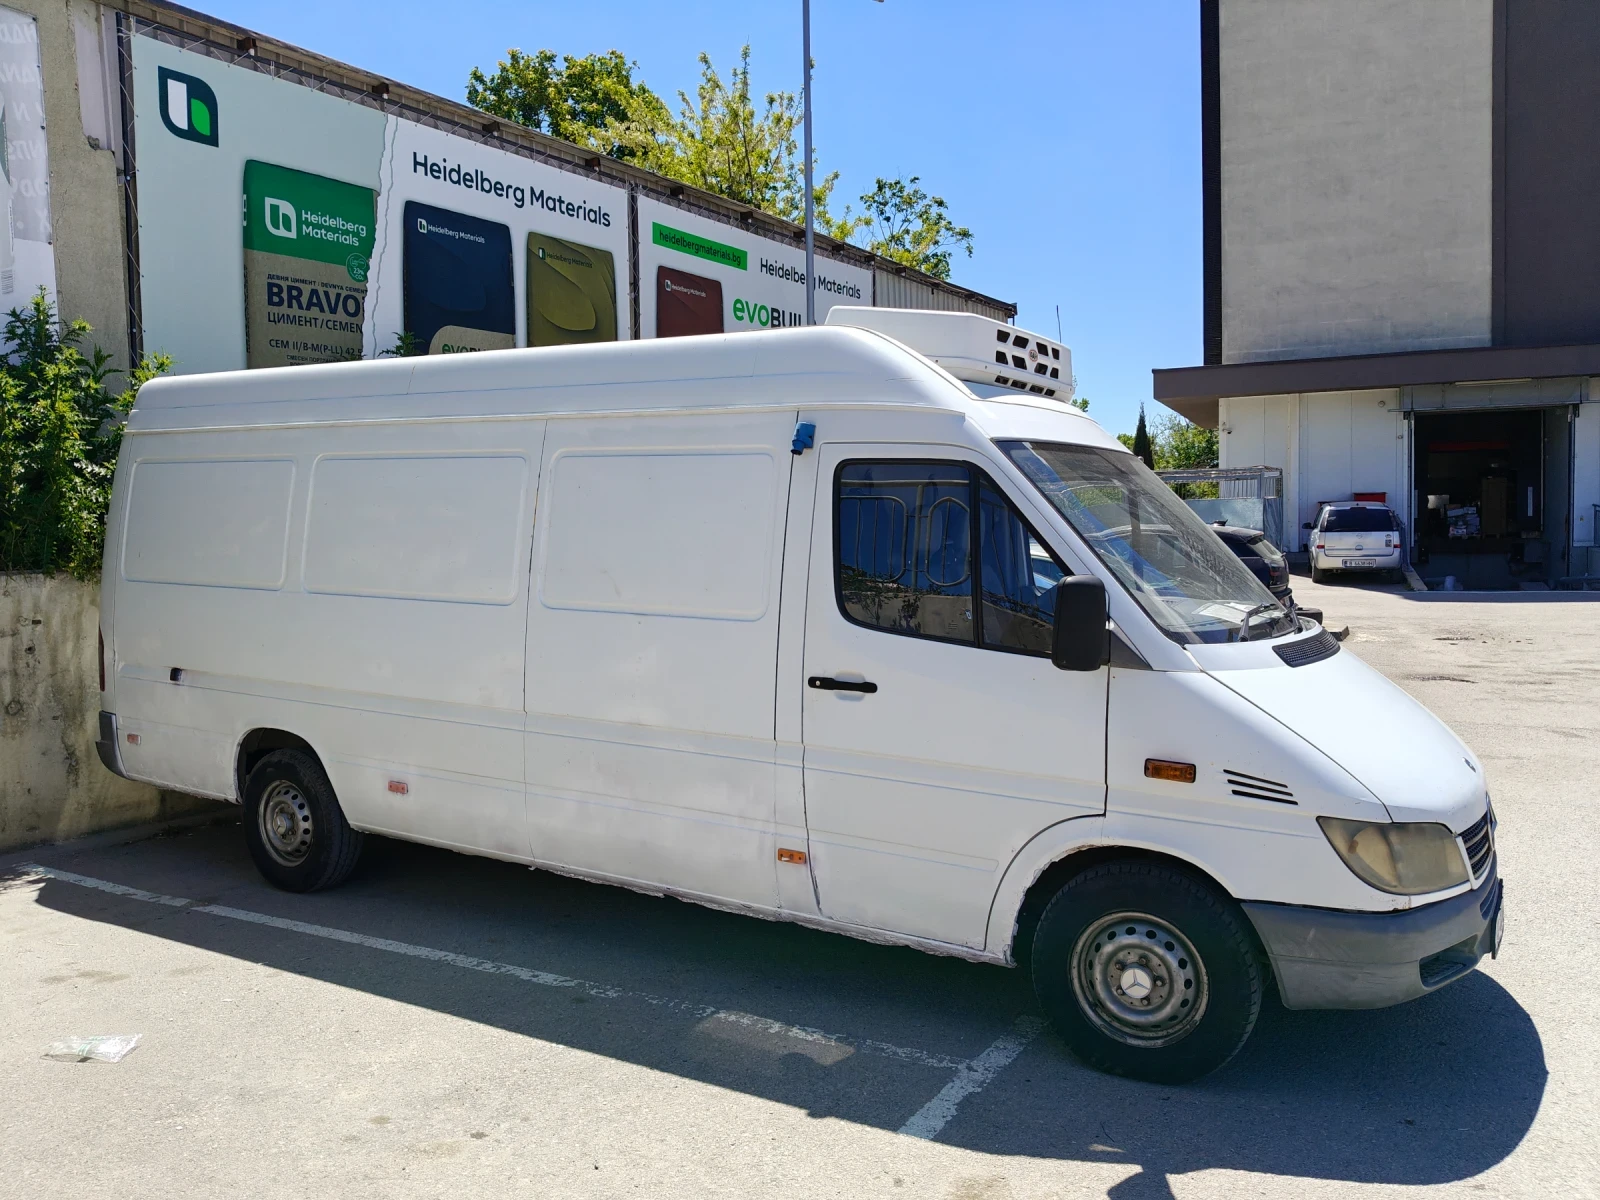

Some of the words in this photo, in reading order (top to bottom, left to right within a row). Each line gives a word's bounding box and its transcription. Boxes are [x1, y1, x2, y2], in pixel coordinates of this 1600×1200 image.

[413, 151, 525, 208] Heidelberg
[530, 186, 611, 227] Materials
[301, 209, 366, 237] Heidelberg
[302, 224, 359, 246] Materials
[428, 224, 459, 239] Heidelberg
[460, 231, 485, 244] Materials
[659, 229, 742, 266] heidelbergmaterials.bg
[760, 257, 816, 291] Heidelbe
[818, 275, 861, 299] Materials
[267, 281, 361, 318] BRAVO
[269, 338, 290, 350] CEM
